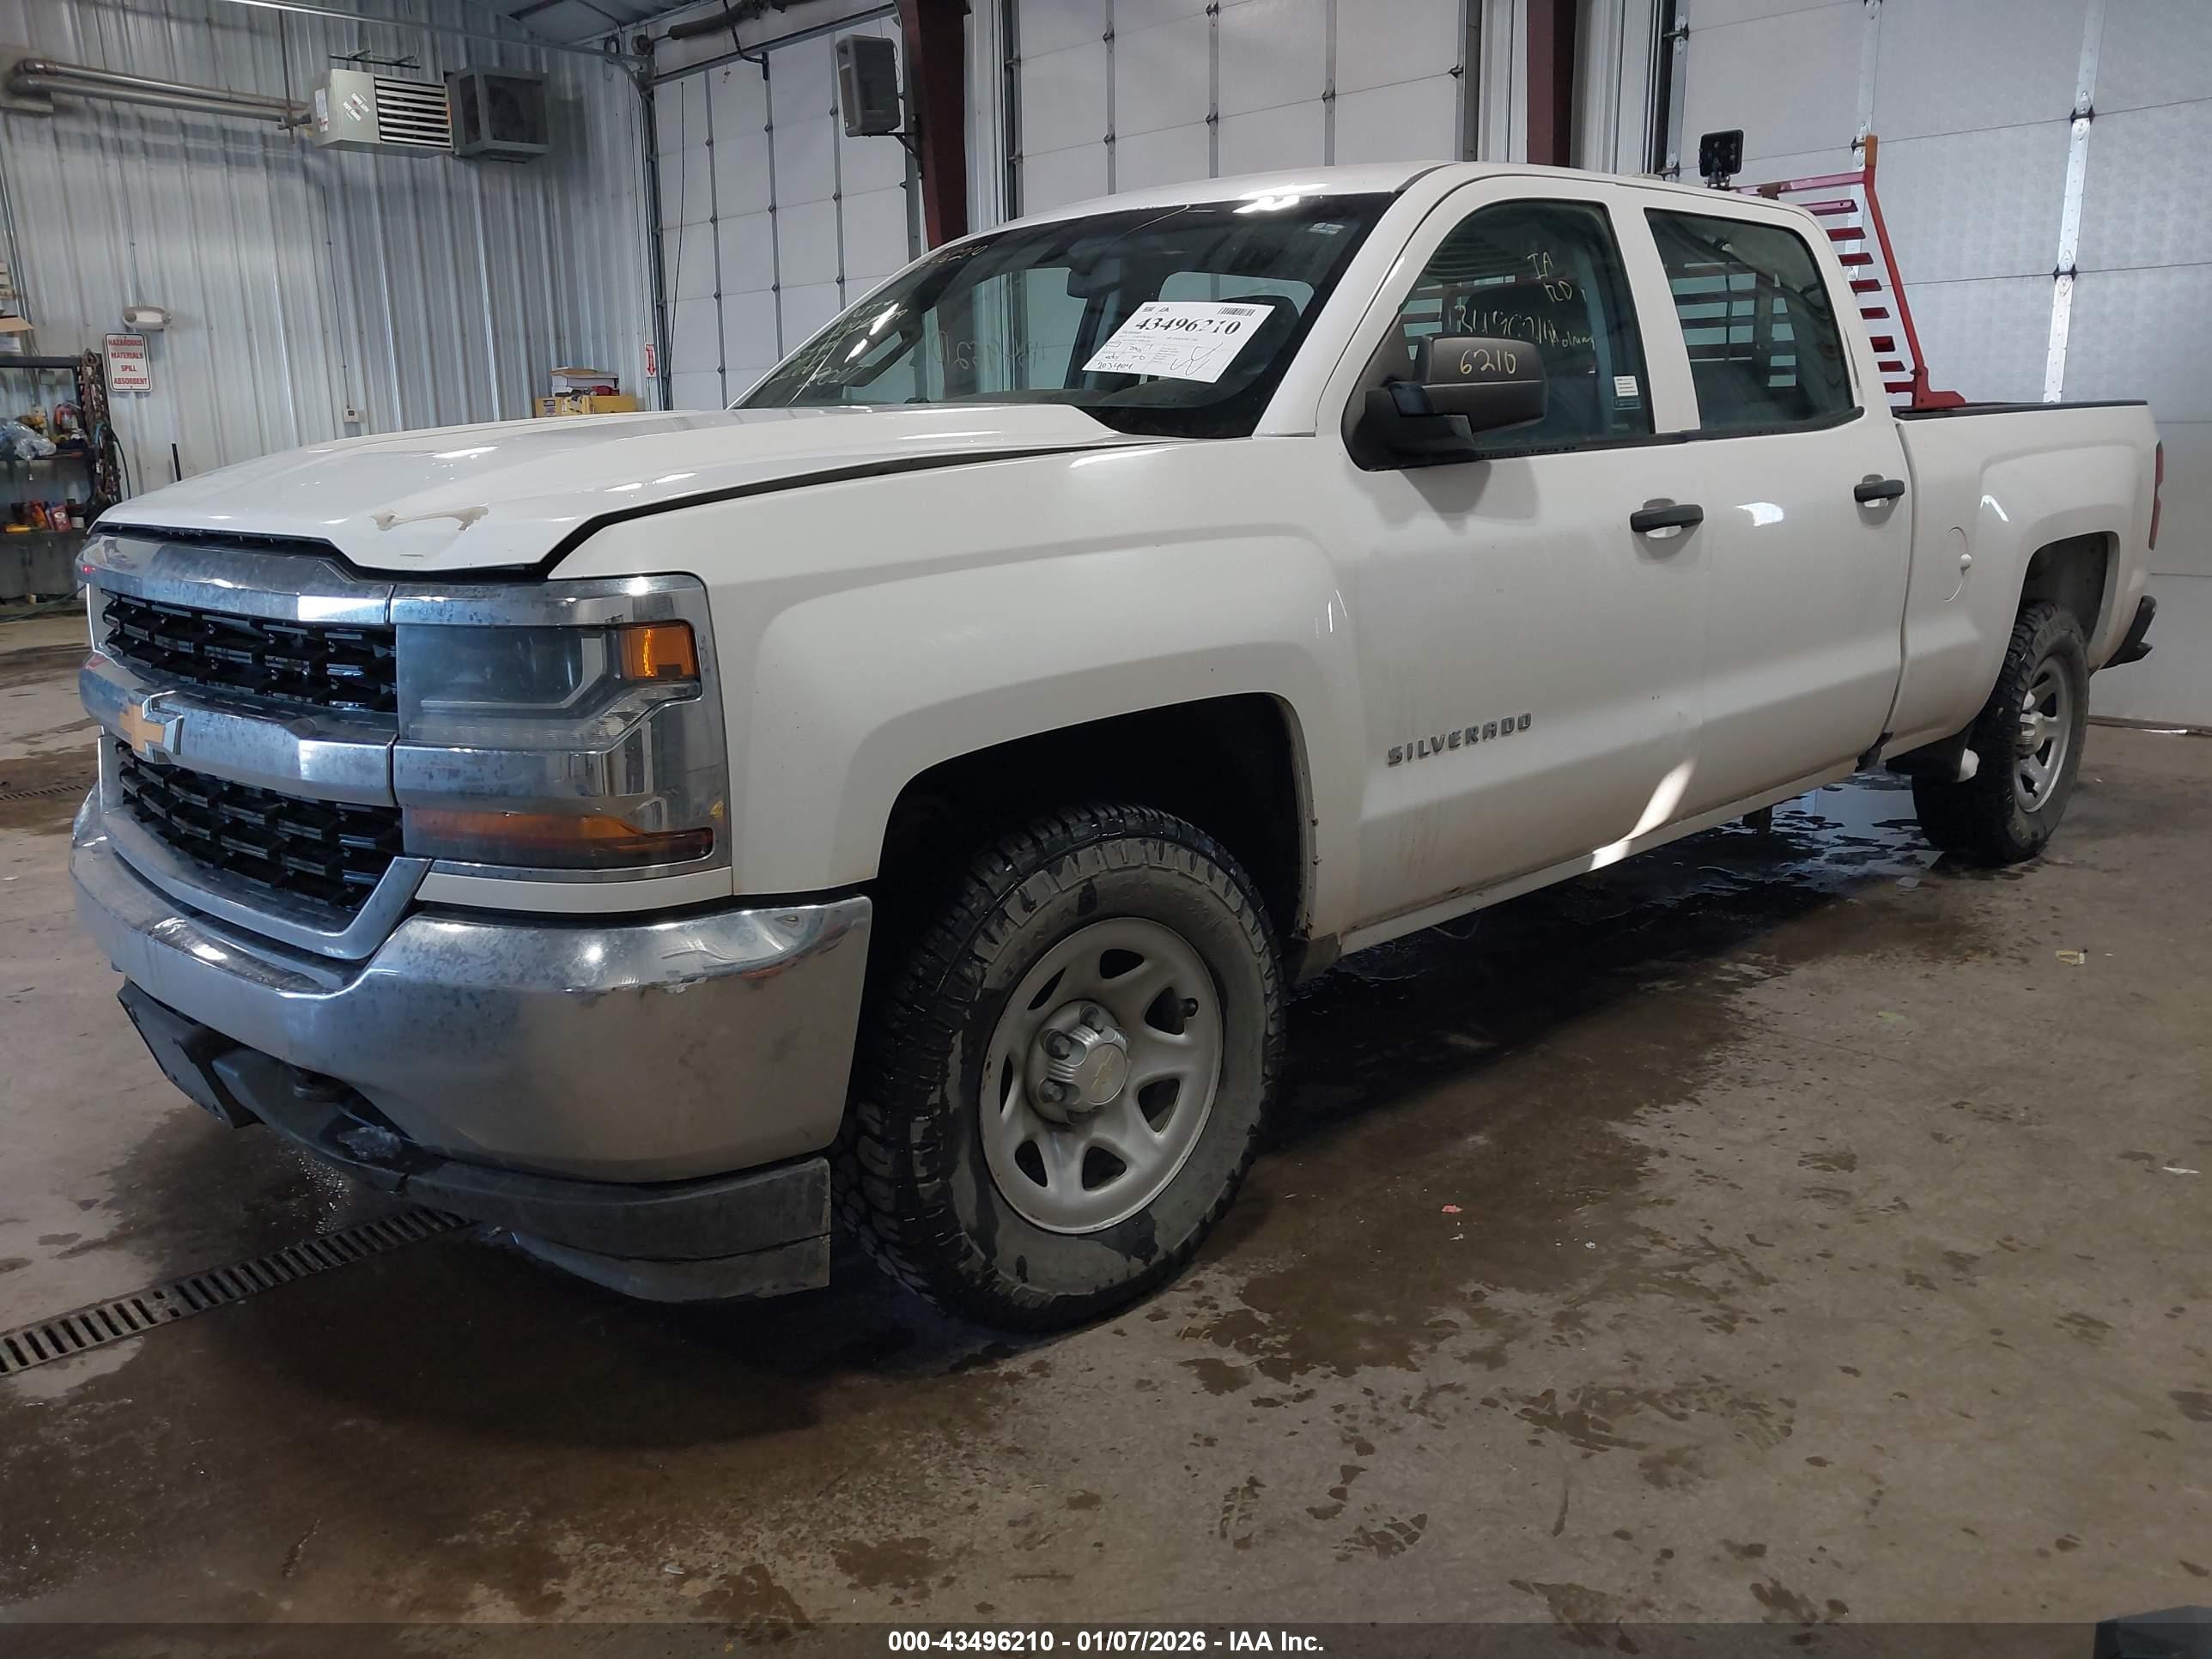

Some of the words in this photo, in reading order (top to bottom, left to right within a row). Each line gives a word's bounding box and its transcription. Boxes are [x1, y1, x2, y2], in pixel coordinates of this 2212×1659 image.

[1135, 317, 1242, 335] 43496210
[1460, 349, 1516, 374] 6210
[1388, 712, 1532, 766] SILVERADO
